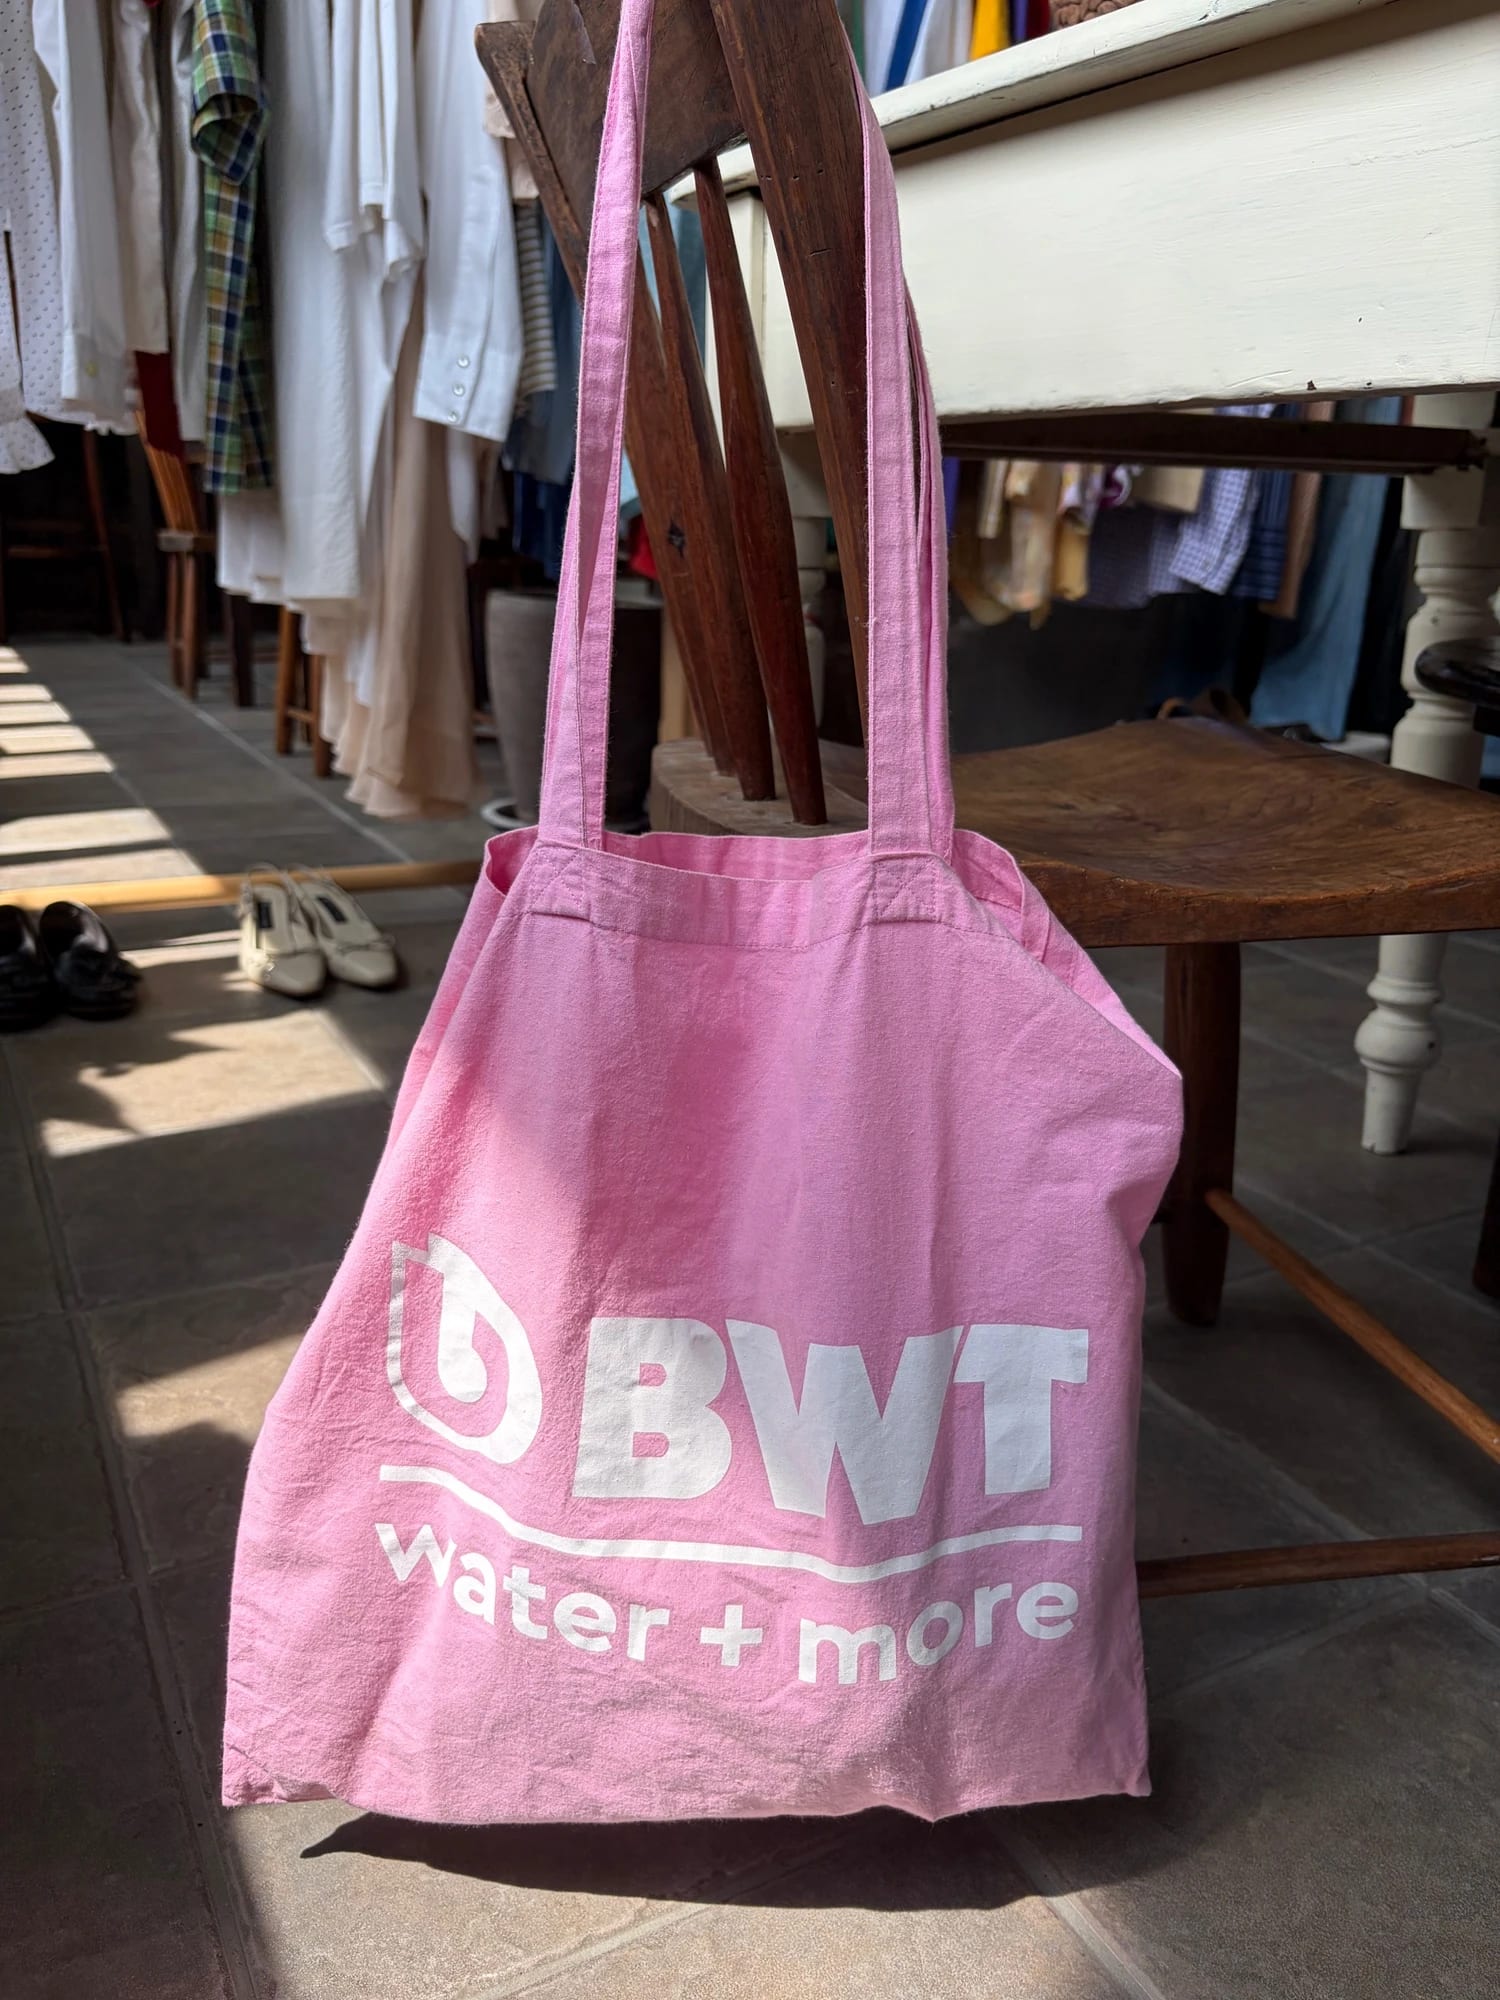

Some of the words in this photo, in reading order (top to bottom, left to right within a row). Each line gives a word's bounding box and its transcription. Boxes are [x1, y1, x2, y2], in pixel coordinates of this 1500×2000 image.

[572, 1316, 1089, 1525] BWT
[374, 1522, 669, 1661] water
[700, 1604, 763, 1667] +
[798, 1581, 1081, 1685] more
